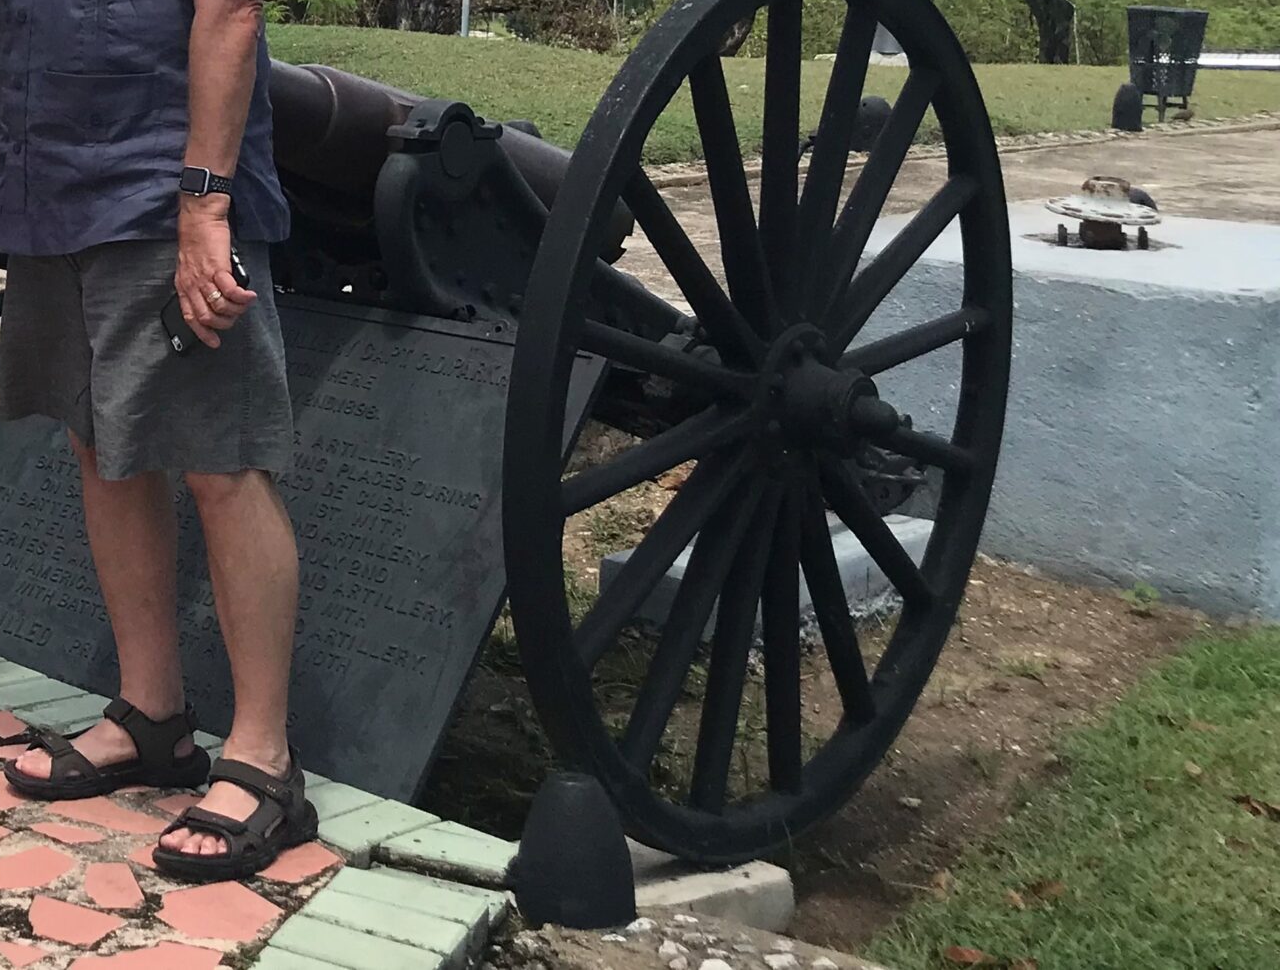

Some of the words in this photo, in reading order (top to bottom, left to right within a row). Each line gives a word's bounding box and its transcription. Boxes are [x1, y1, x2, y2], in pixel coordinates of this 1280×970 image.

[326, 368, 377, 390] HERE
[311, 435, 422, 471] ARTILLERY
[320, 481, 349, 501] DE
[409, 479, 483, 510] DURING
[15, 491, 84, 524] BATTER
[38, 477, 62, 494] ON
[297, 546, 347, 570] JULY
[347, 558, 390, 585] 2ND
[350, 512, 407, 538] WITH
[0, 552, 24, 570] ON
[50, 545, 66, 561] E
[20, 517, 45, 532] AT
[44, 521, 65, 539] EL
[319, 601, 367, 629] WITH
[14, 580, 56, 604] WITH
